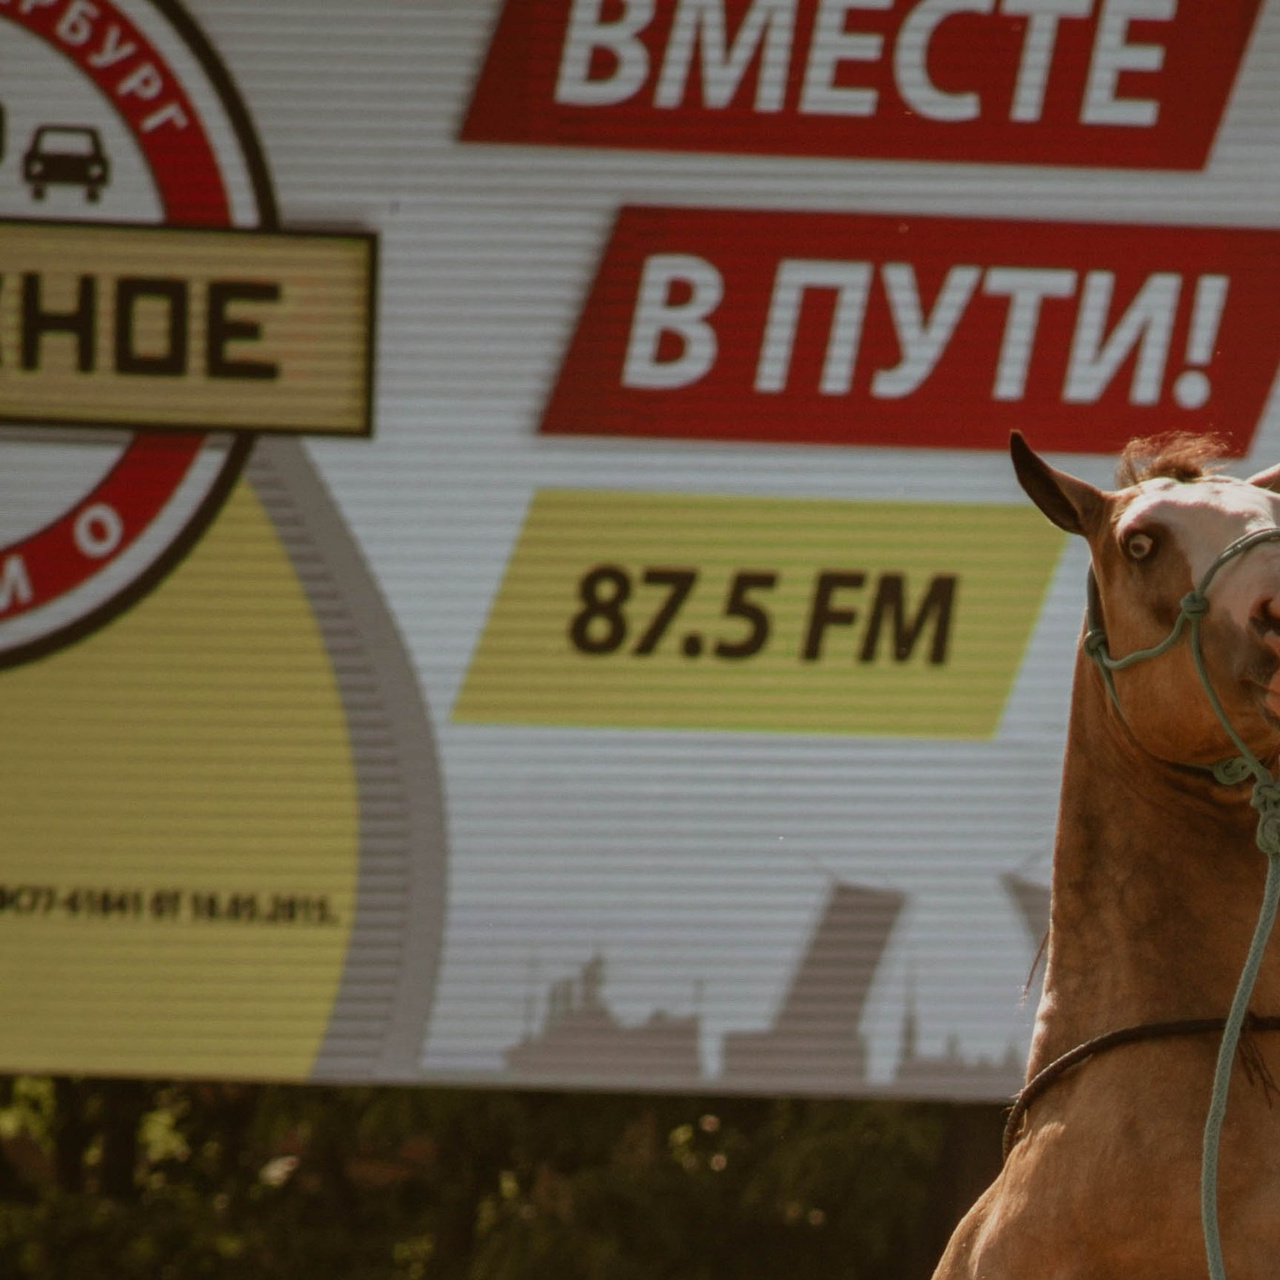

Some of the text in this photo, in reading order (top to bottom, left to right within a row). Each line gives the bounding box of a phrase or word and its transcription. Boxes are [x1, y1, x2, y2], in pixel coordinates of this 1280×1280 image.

[0, 0, 188, 132] БУРГ
[555, 0, 1176, 126] ВМЕСТЕ
[0, 271, 282, 380] НОЕ
[621, 254, 1230, 409] В ПУТИ!
[568, 562, 959, 667] 87.5 FM
